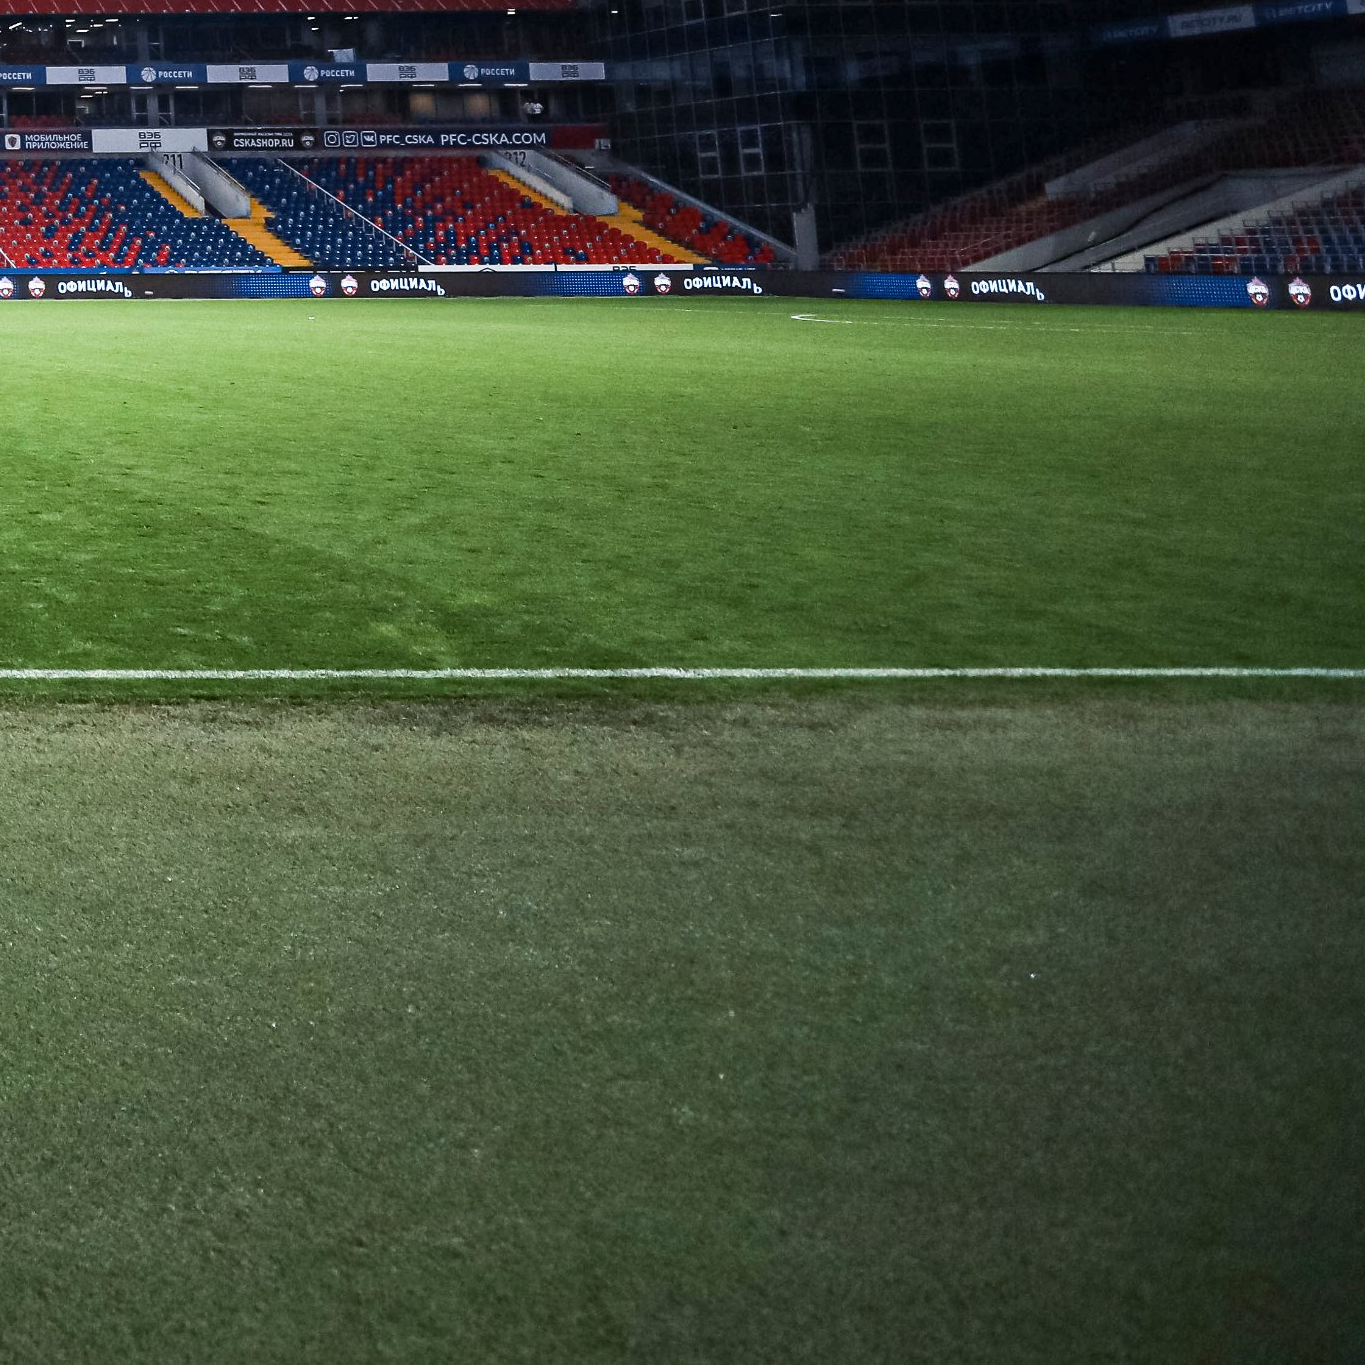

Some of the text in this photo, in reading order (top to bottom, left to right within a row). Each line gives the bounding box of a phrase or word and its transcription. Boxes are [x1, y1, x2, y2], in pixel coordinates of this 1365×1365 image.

[159, 71, 193, 79] РОССЕТИ
[481, 68, 515, 76] РОССЕТИ
[234, 139, 293, 147] CSKASHOP.RU
[379, 135, 435, 146] PFC_CSKA
[441, 133, 546, 145] PFC-CSKA.COM
[58, 280, 131, 298] ОФИЦИАЛЬ
[371, 278, 445, 296] ОФИЦИАЛЬ
[684, 276, 762, 294] ОФИЦИАЛЬ
[971, 278, 1044, 301] ОФИЦИАЛЬ
